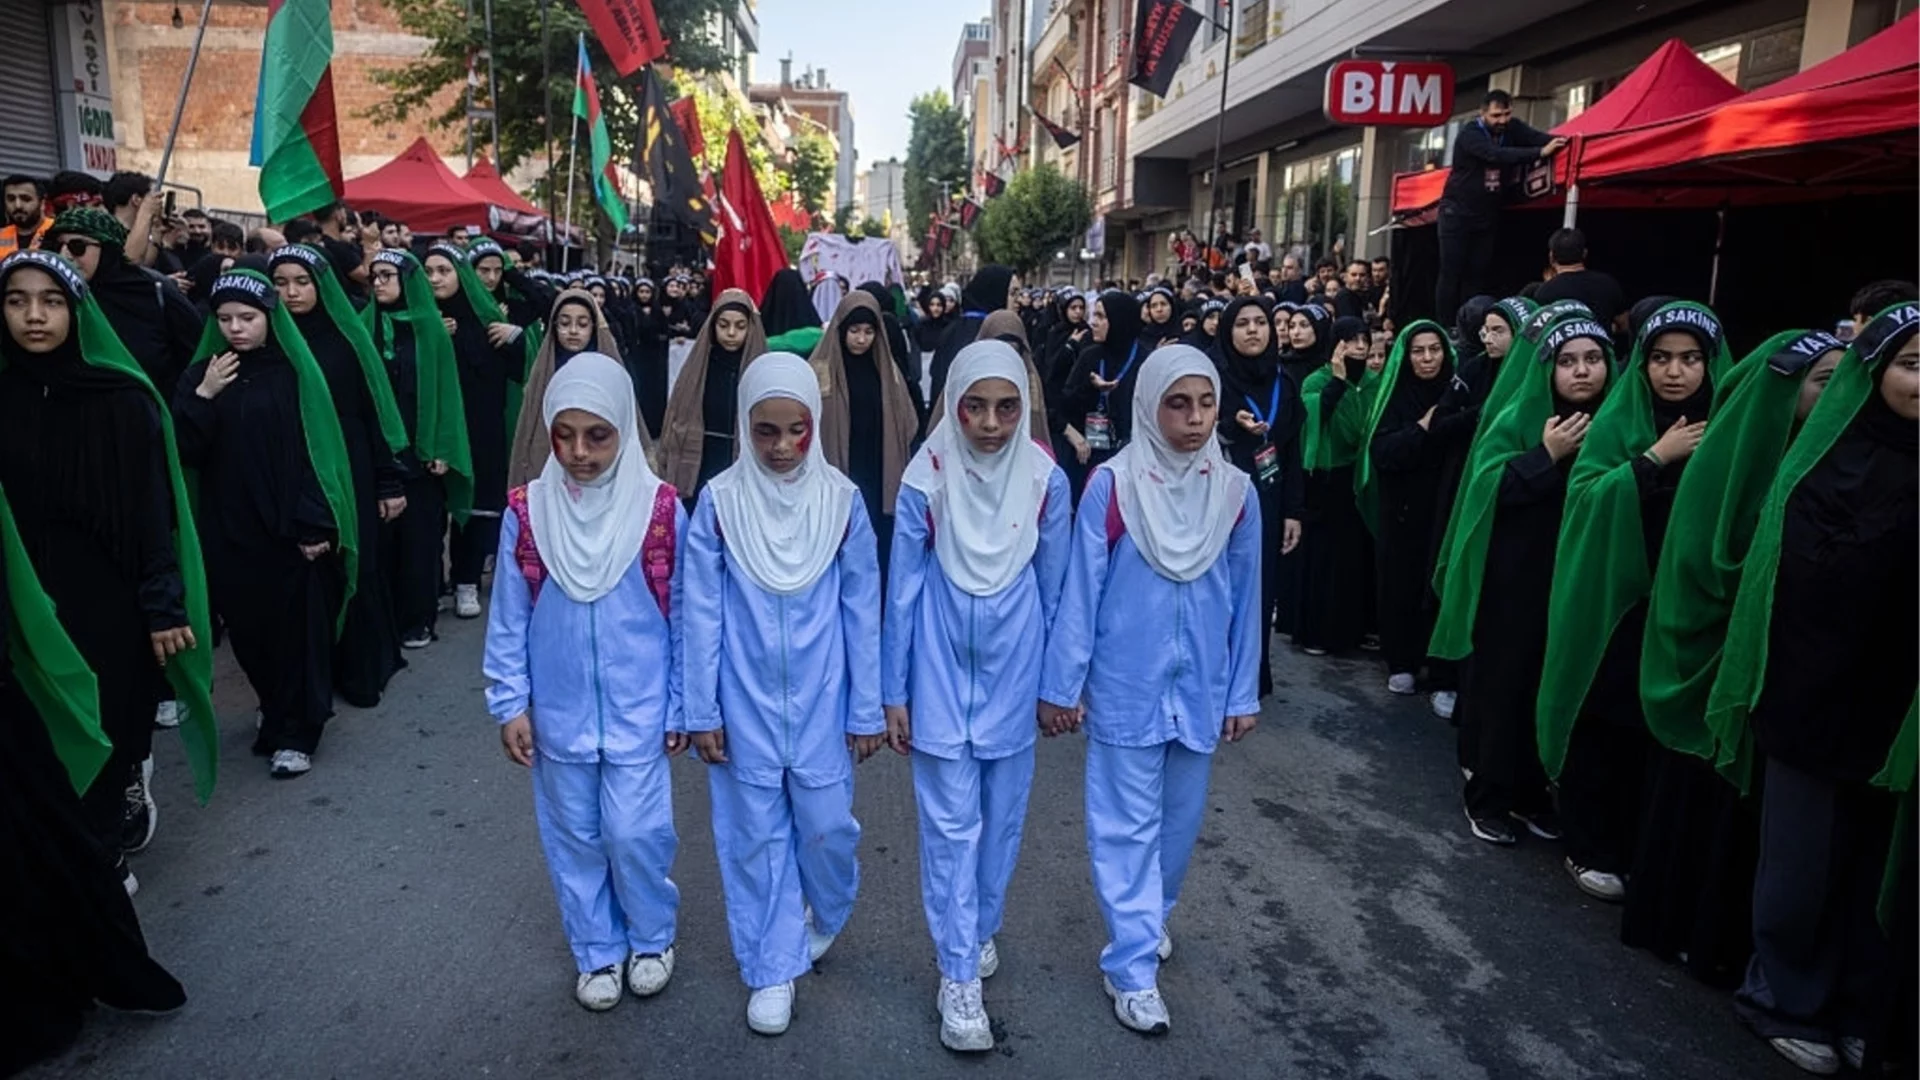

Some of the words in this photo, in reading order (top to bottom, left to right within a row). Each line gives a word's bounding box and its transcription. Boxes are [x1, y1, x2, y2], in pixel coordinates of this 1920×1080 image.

[1341, 61, 1442, 114] BİM
[218, 275, 266, 297] SAKİNE
[1532, 311, 1553, 328] YA
[1665, 309, 1718, 338] SAKİNE
[1887, 306, 1920, 325] YA
[1547, 330, 1563, 349] YA
[1790, 336, 1827, 356] YA
